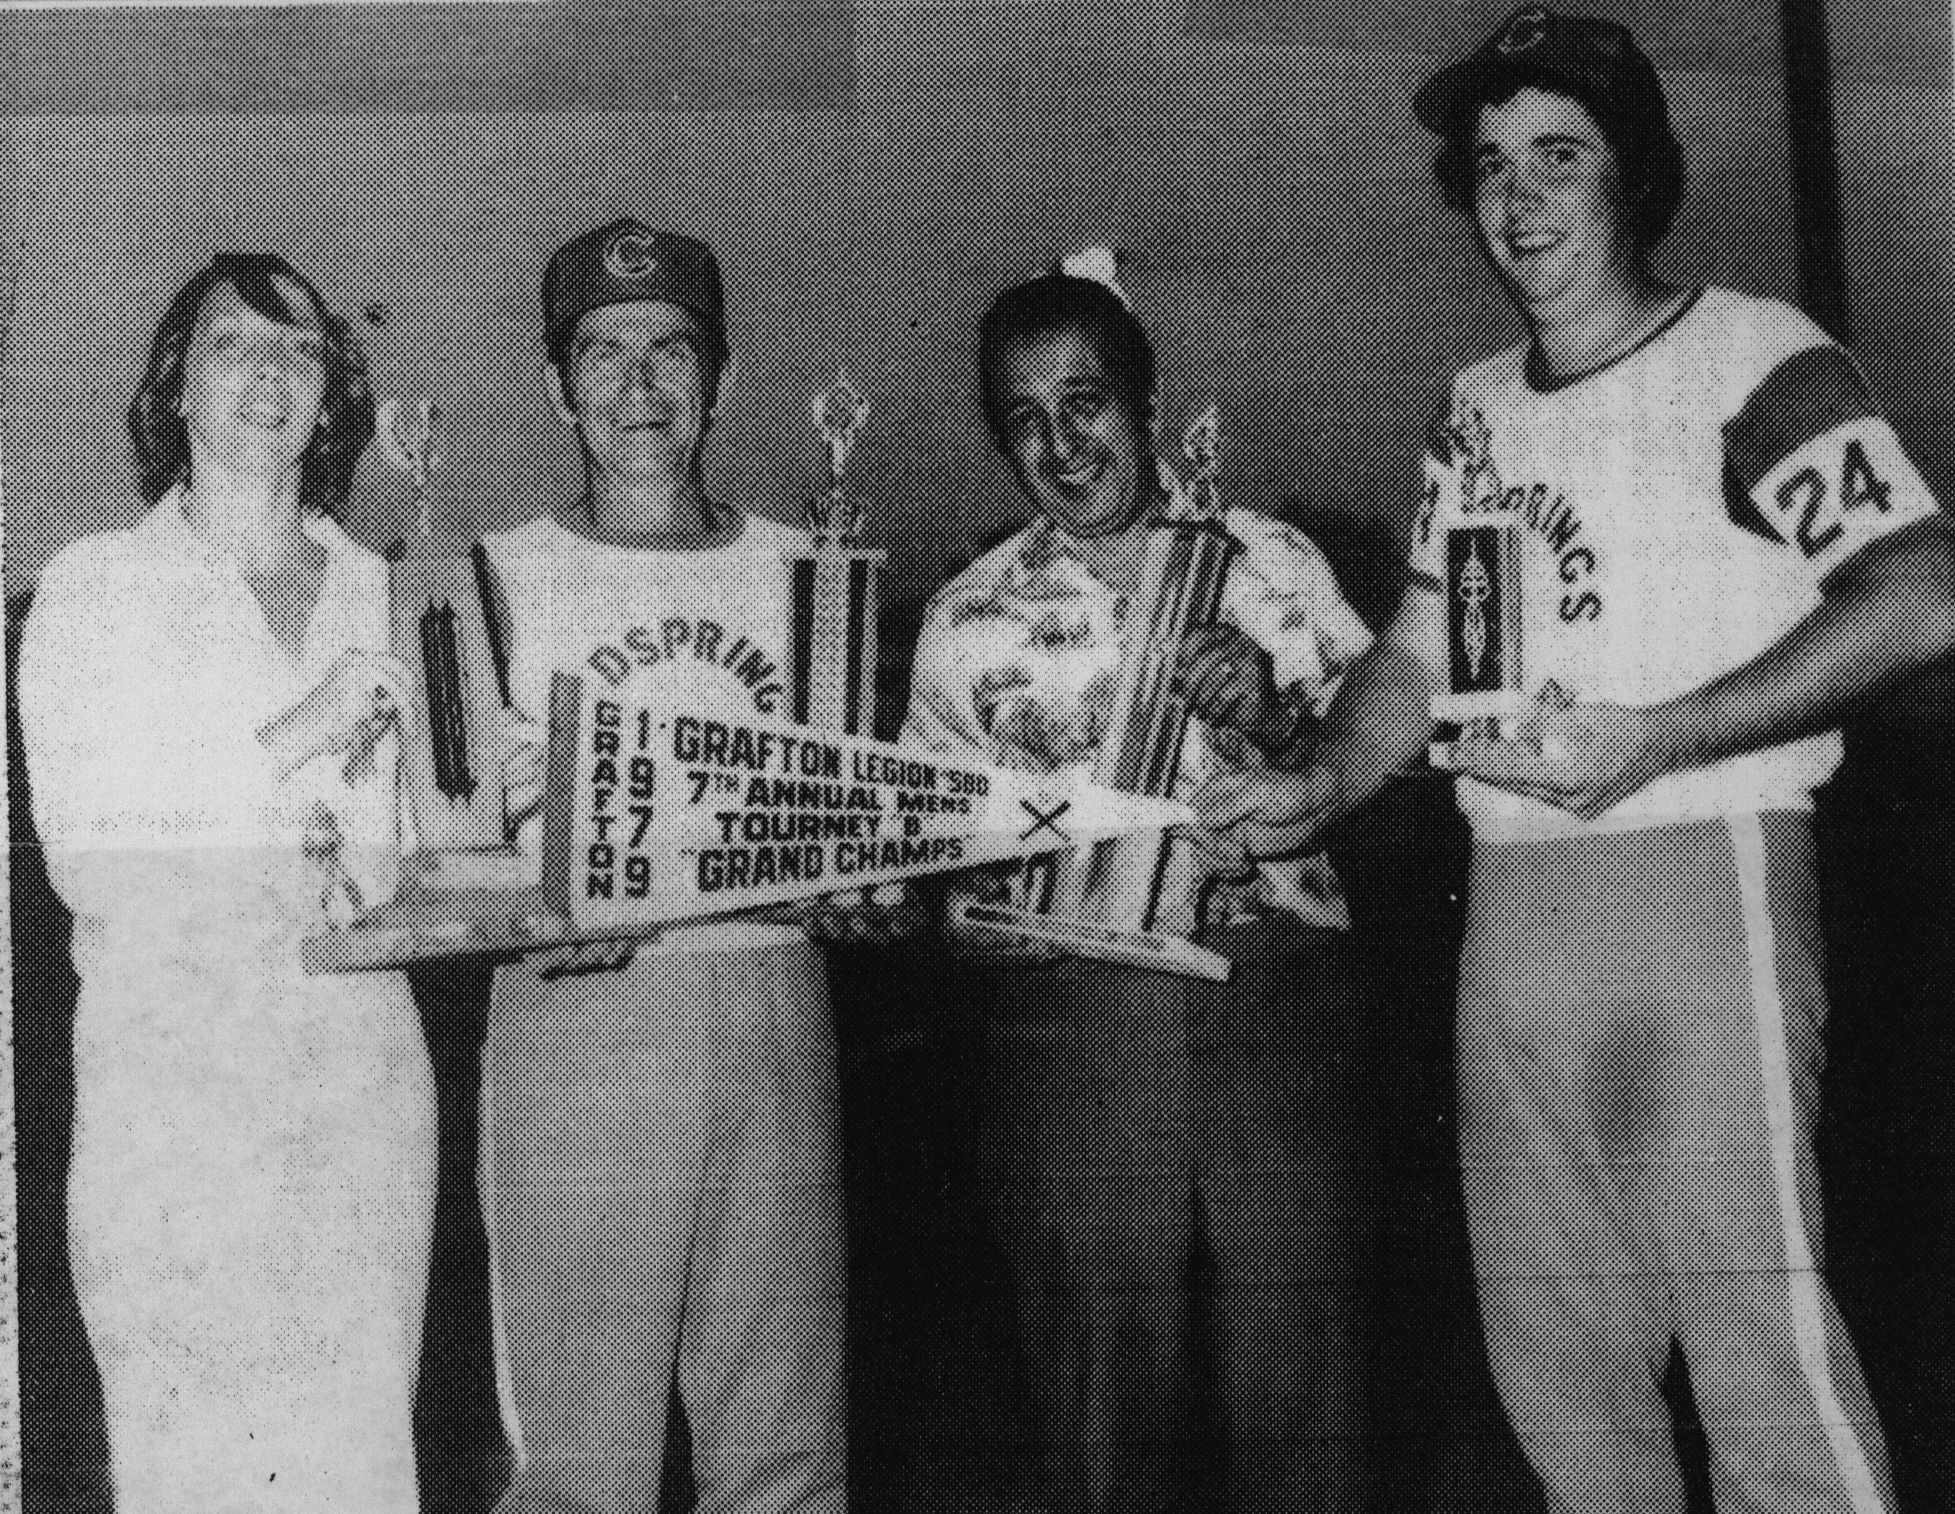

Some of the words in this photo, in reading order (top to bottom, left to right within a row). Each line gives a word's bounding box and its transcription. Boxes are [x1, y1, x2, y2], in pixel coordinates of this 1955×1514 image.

[602, 228, 658, 280] C
[1775, 439, 1892, 559] 24
[673, 715, 841, 779] GRAFTON
[853, 750, 937, 790] LEGION
[624, 708, 654, 899] 1979
[744, 776, 883, 811] ANNUAL
[714, 811, 881, 844] TOURNEY
